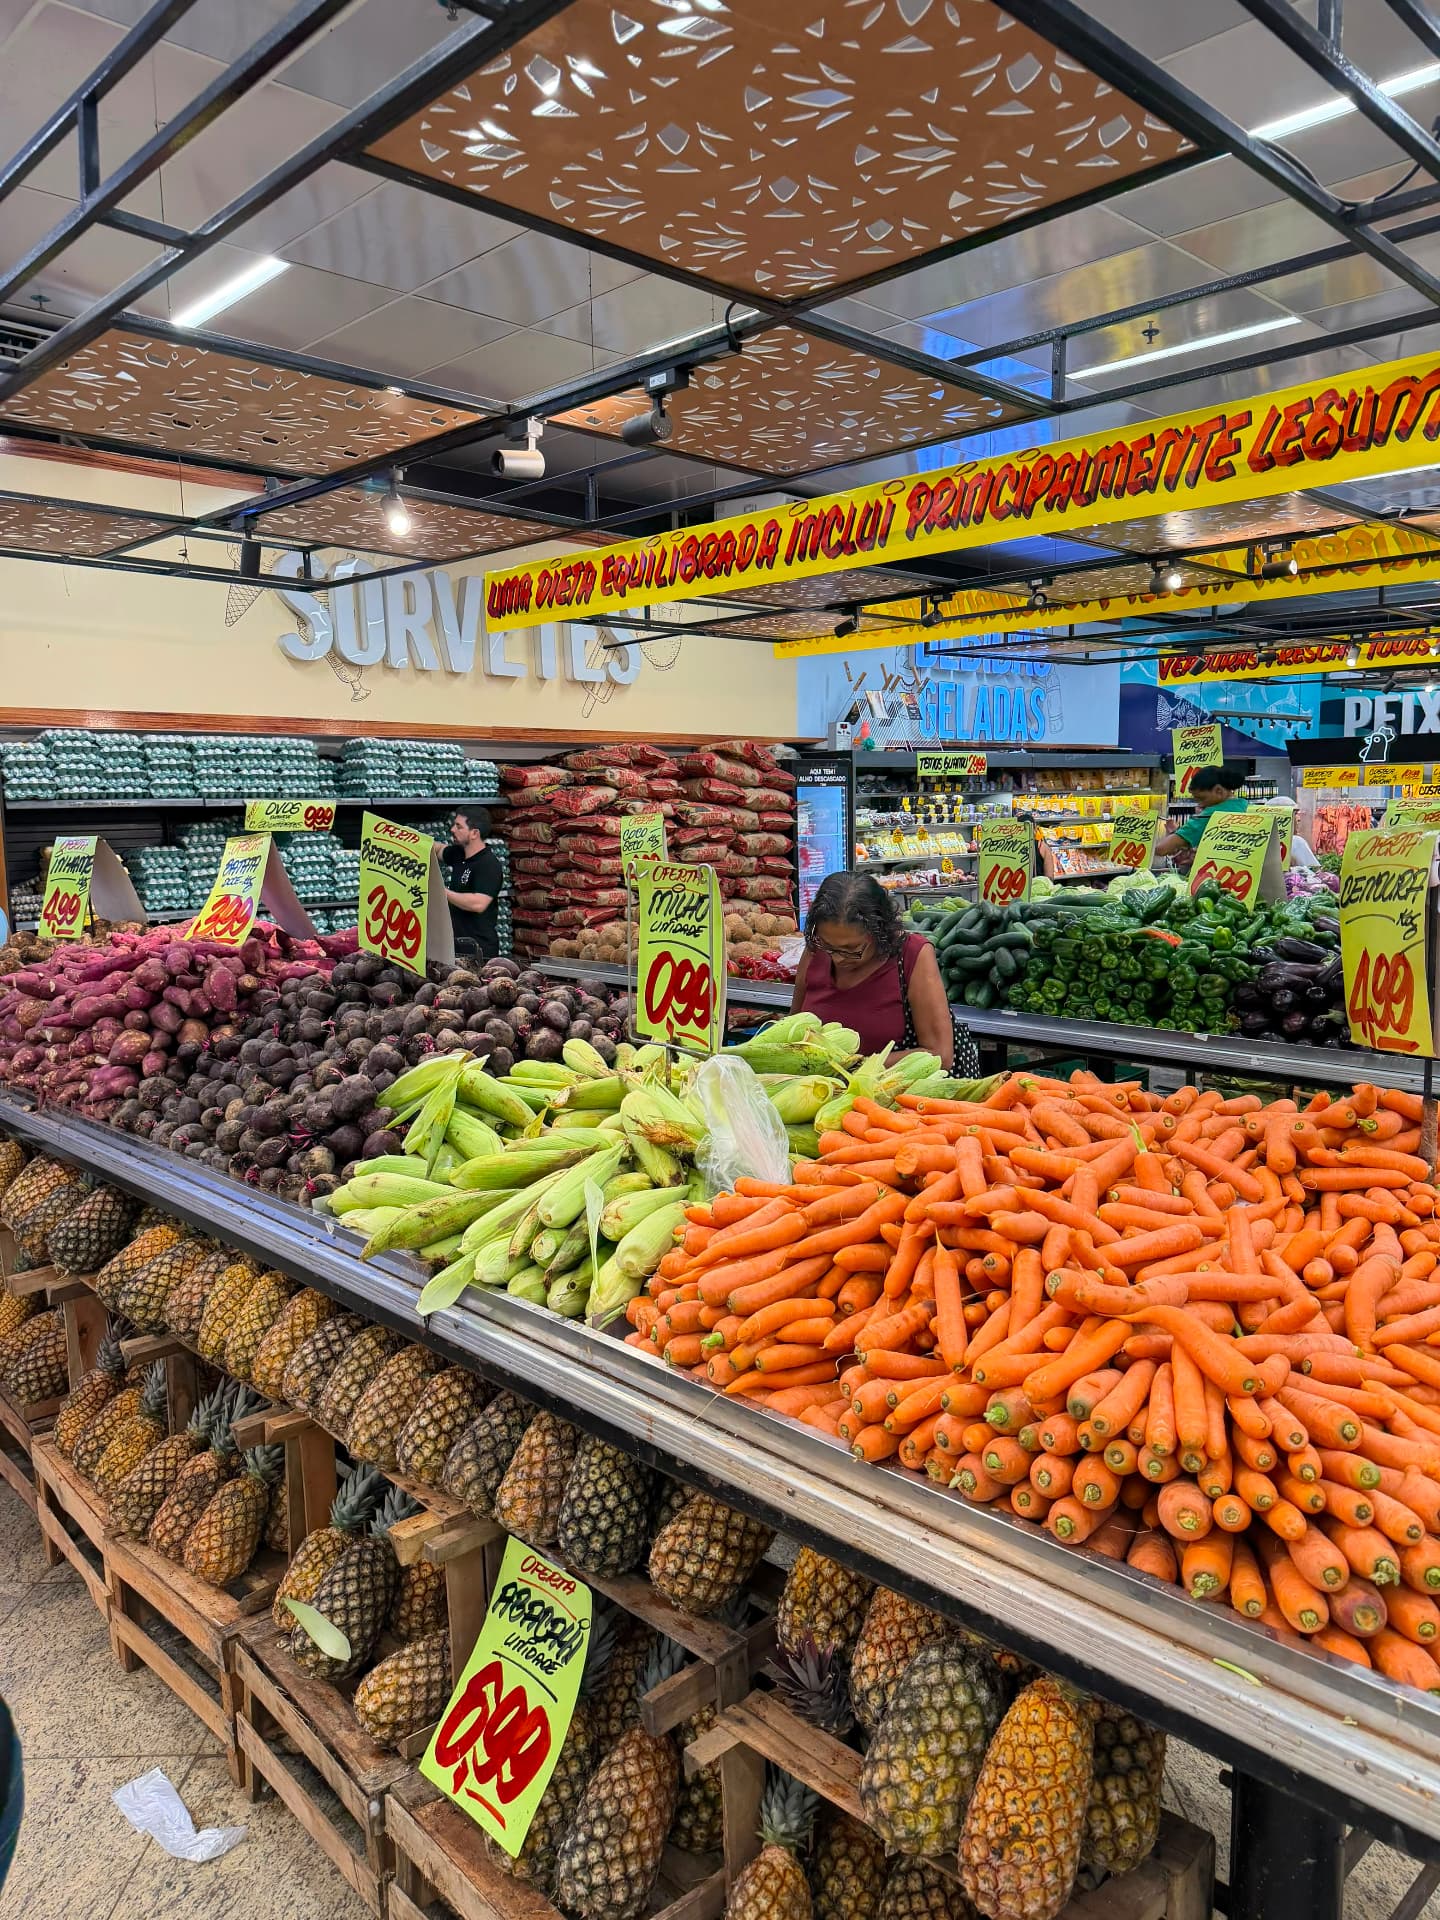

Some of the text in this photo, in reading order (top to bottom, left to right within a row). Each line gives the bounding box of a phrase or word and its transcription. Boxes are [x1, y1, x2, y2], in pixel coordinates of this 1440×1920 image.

[487, 574, 533, 618] UMA
[536, 558, 598, 610] DIETA
[600, 518, 783, 598] EQUILIBRADA
[784, 480, 906, 567] INCLUI
[905, 409, 1253, 541] PRINCIPALMENTE
[918, 677, 1047, 742] GELADAS
[265, 802, 303, 816] OVOS
[373, 821, 421, 845] OFERTA
[622, 828, 648, 841] COCO
[622, 840, 645, 852] SECO
[982, 835, 1022, 852] PEPINO
[652, 865, 706, 886] OFERTA
[983, 864, 1027, 904] 1,99
[1340, 867, 1430, 909] CENOURA
[43, 886, 81, 934] 4,99
[365, 885, 422, 960] 3,99
[648, 885, 710, 922] MILHO
[650, 918, 708, 938] UNIDADE
[645, 951, 717, 1041] 0,99
[1349, 946, 1415, 1048] 4,99
[520, 1555, 577, 1596] OFERTA
[492, 1581, 591, 1666] ABACAXI
[503, 1631, 566, 1675] UNIDADE
